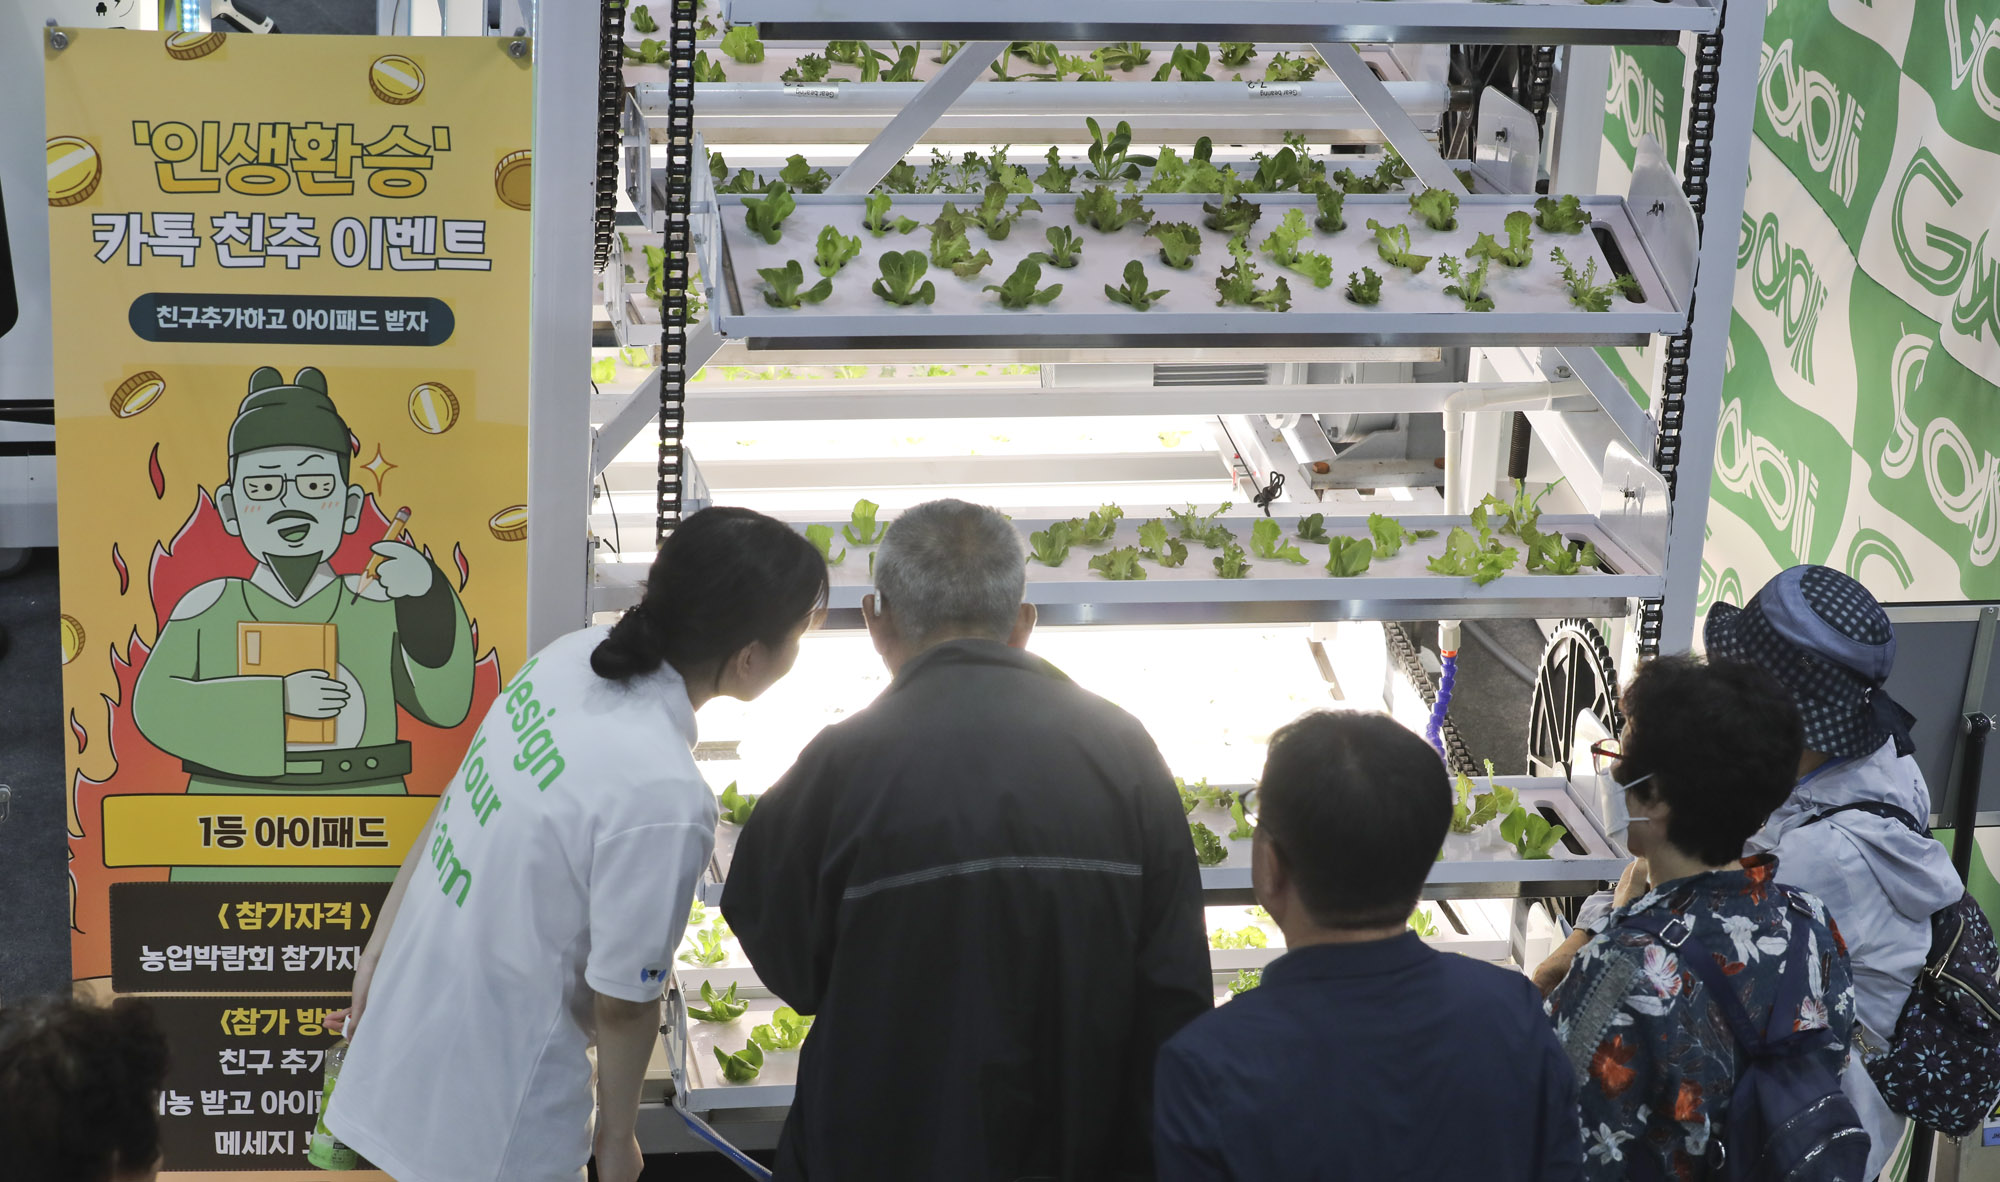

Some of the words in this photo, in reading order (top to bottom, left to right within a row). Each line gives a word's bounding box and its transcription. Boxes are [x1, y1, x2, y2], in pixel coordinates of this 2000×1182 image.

[91, 211, 201, 268] 카톡
[210, 211, 320, 269] 친추
[331, 215, 492, 271] 이벤트
[156, 305, 287, 331] 친구추가하고
[292, 308, 379, 332] 아이패드
[384, 309, 429, 333] 받자
[198, 815, 247, 849] 1등
[254, 816, 390, 849] 아이패드
[235, 901, 352, 931] 참가자격
[139, 944, 274, 972] 농업박람회
[218, 1048, 274, 1075] 친구
[159, 1089, 194, 1116] 농
[200, 1089, 254, 1116] 받고
[215, 1130, 294, 1156] 메세지
